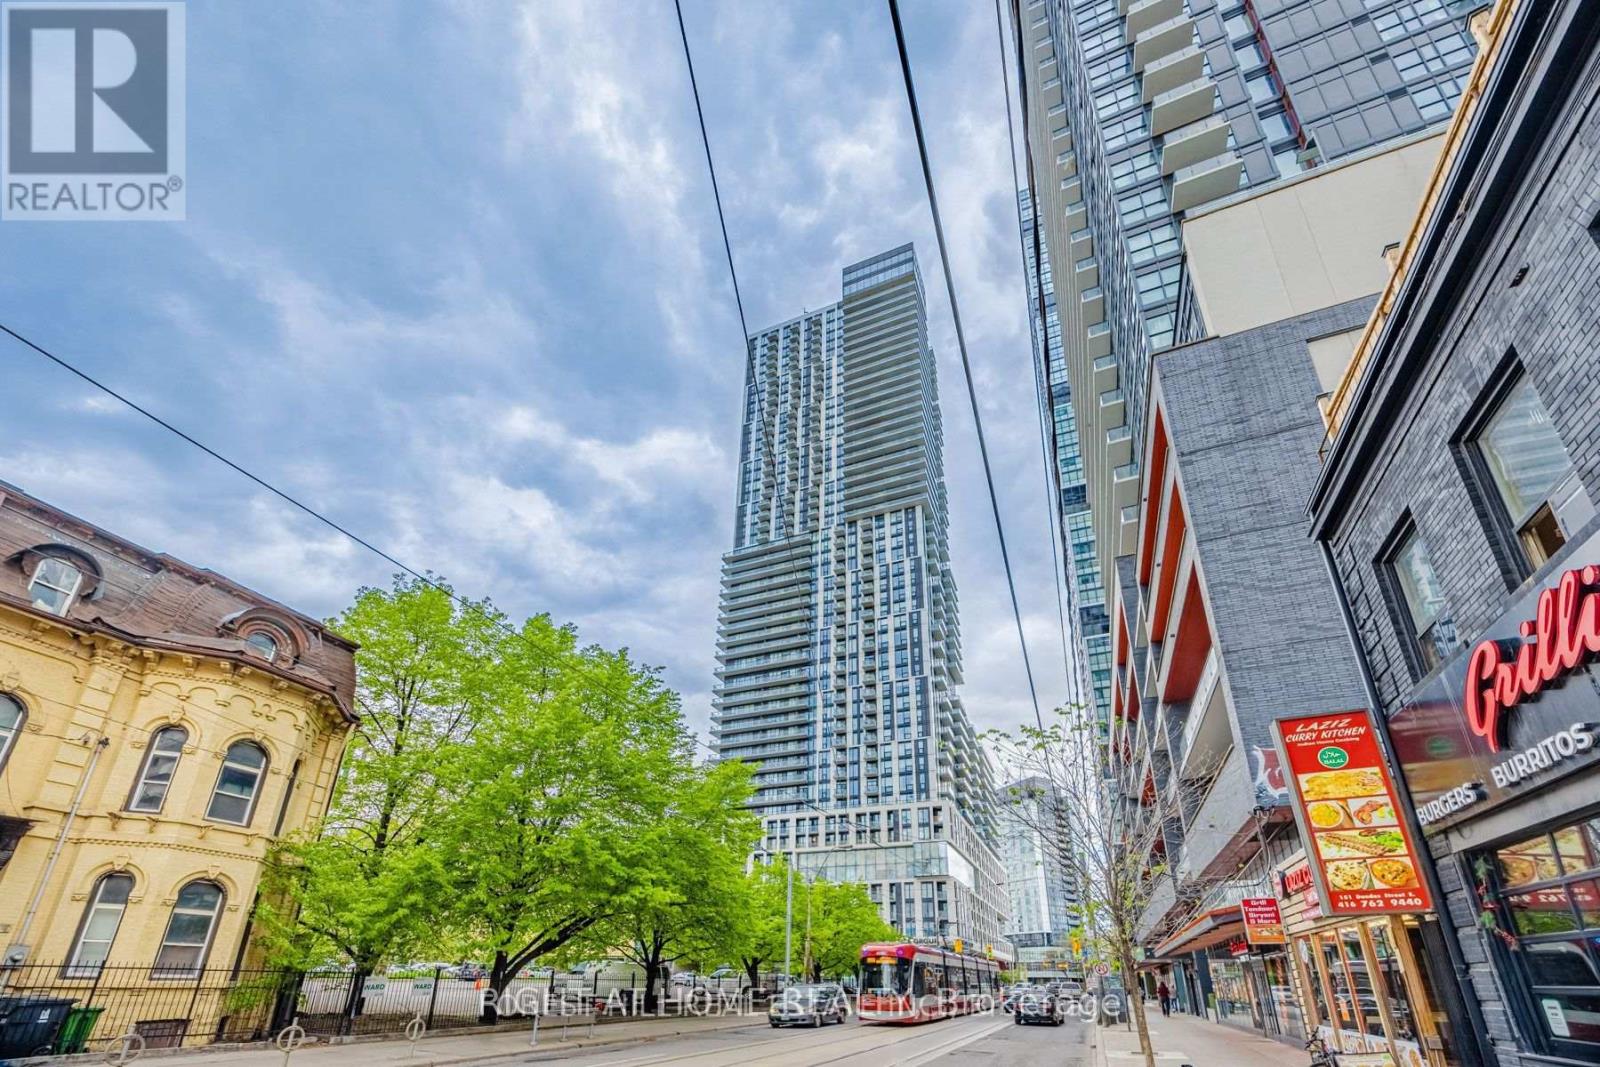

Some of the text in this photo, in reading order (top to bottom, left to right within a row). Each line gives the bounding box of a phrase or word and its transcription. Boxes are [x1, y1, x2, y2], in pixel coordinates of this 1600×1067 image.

[1296, 719, 1352, 732] LAZIZ
[1286, 727, 1366, 743] CURRY KITCHEN
[1490, 722, 1594, 789] BURRITOS
[1416, 783, 1477, 825] BURGERS
[1360, 899, 1385, 907] 762
[1390, 898, 1422, 907] 9440
